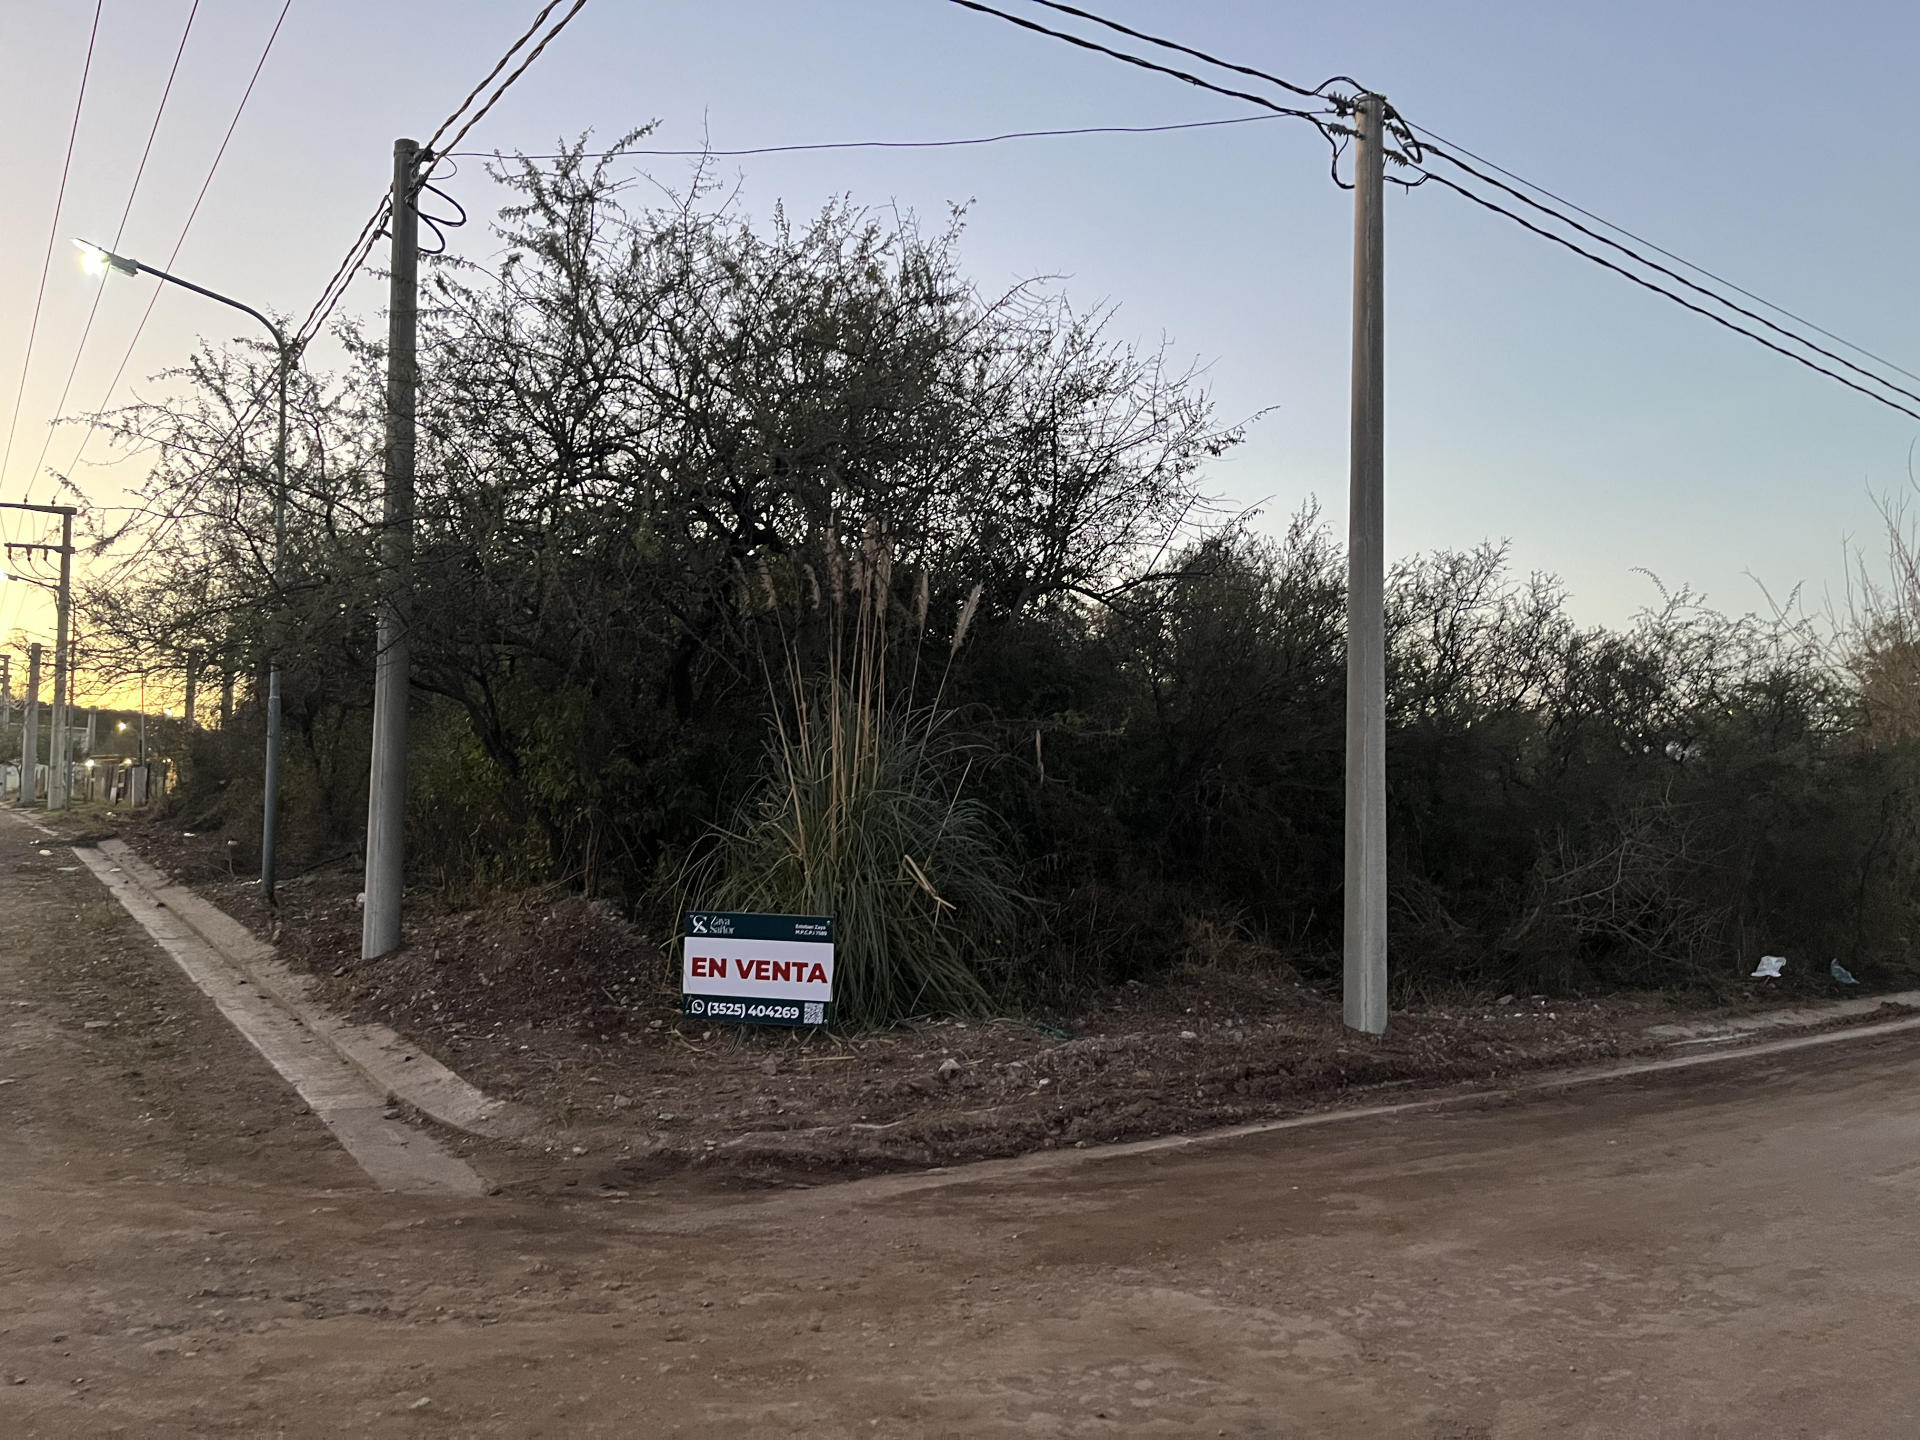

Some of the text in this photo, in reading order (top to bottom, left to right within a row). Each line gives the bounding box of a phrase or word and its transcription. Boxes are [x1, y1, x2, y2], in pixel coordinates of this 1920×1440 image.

[691, 957, 828, 984] EN VENTA
[707, 1002, 799, 1019] (3525) 404269
